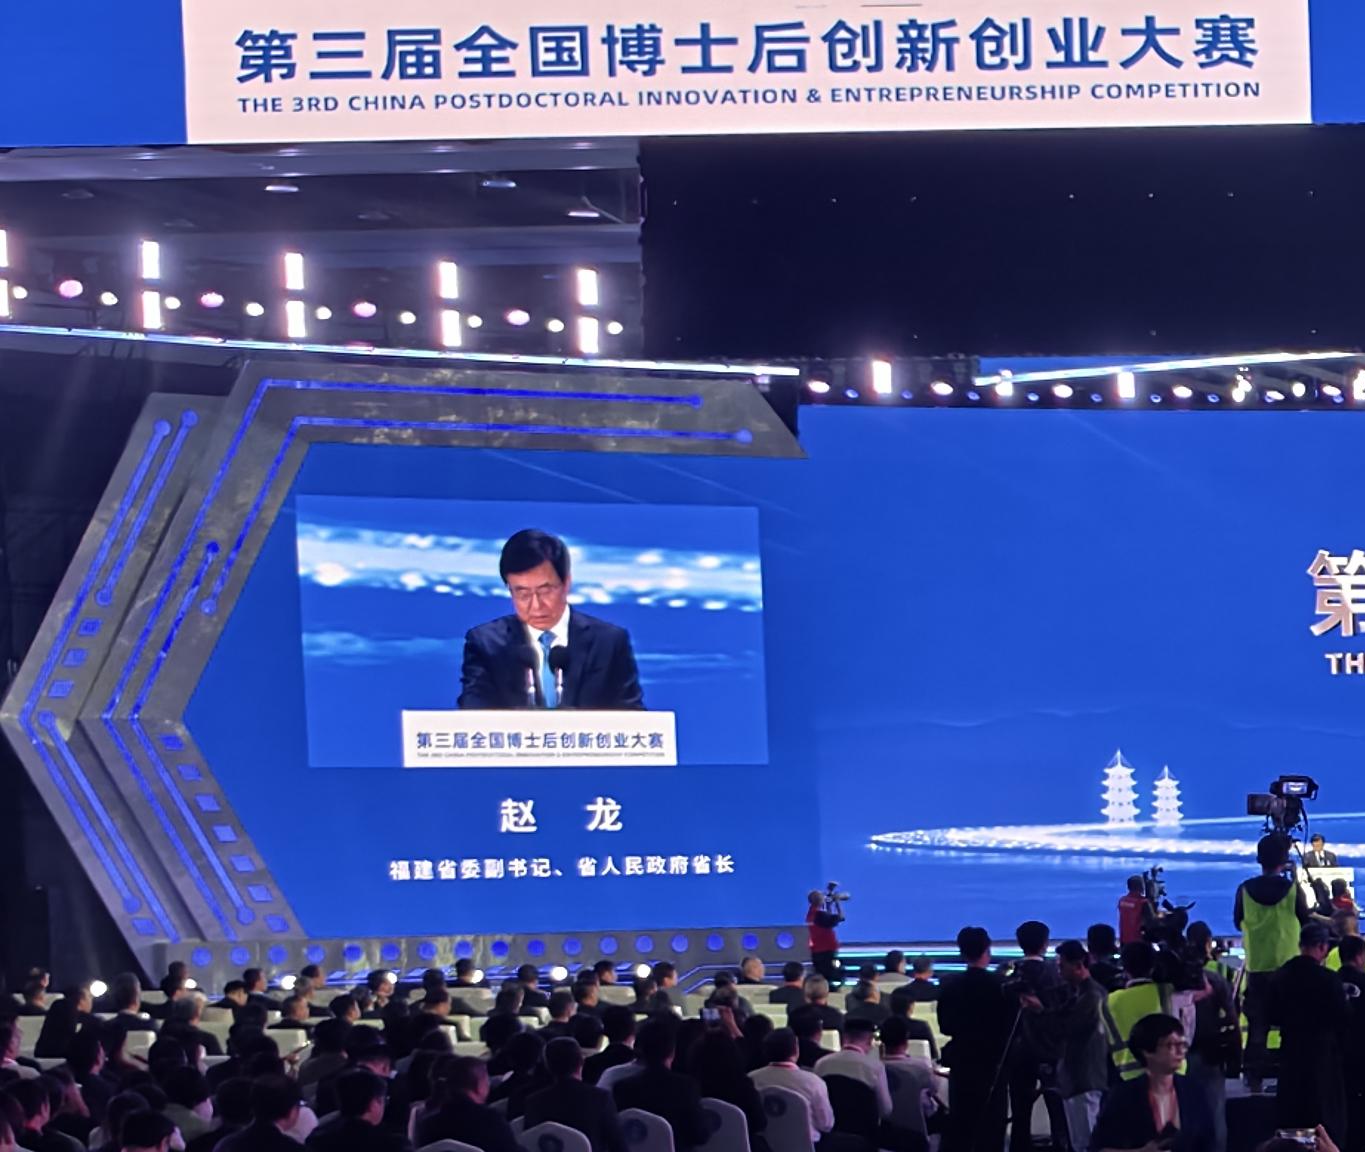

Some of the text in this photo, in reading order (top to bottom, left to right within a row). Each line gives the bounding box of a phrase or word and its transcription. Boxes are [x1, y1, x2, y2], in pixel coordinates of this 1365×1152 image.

[235, 15, 1259, 82] 第三届全国博士后创新创业大赛
[237, 81, 1260, 113] THE 3RD CHINA POSTDOCTORAL INNOVATION & ENTREPRENEURSHIP COMPETITION
[416, 732, 664, 750] 第三届全国博士后创新创业大赛
[500, 797, 624, 833] 赵龙
[389, 854, 736, 881] 福建省委副书记、省人民政府省长
